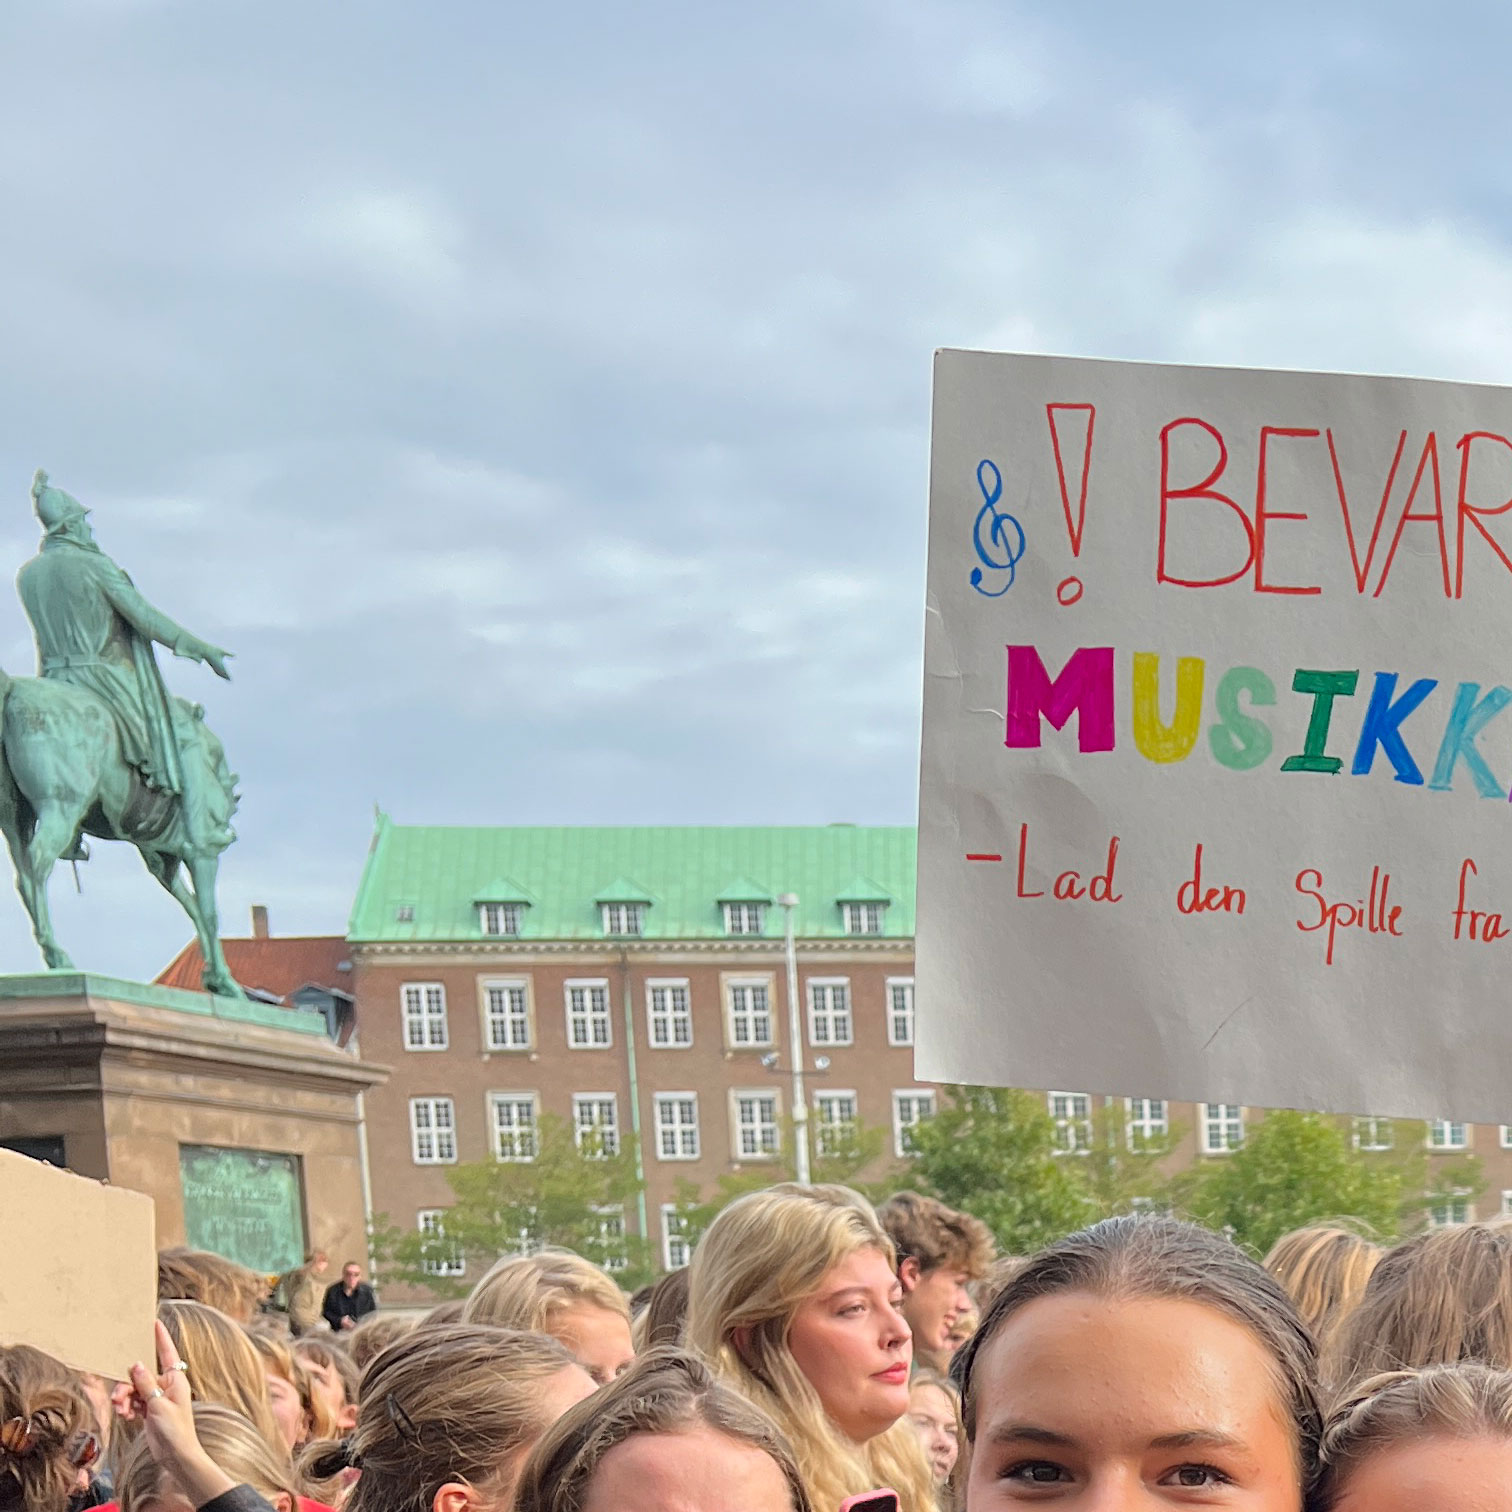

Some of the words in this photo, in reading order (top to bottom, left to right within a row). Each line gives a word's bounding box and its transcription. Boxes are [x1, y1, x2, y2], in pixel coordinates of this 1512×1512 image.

[1177, 844, 1246, 914] den
[1296, 866, 1402, 966] Spille
[1452, 859, 1509, 943] fra
